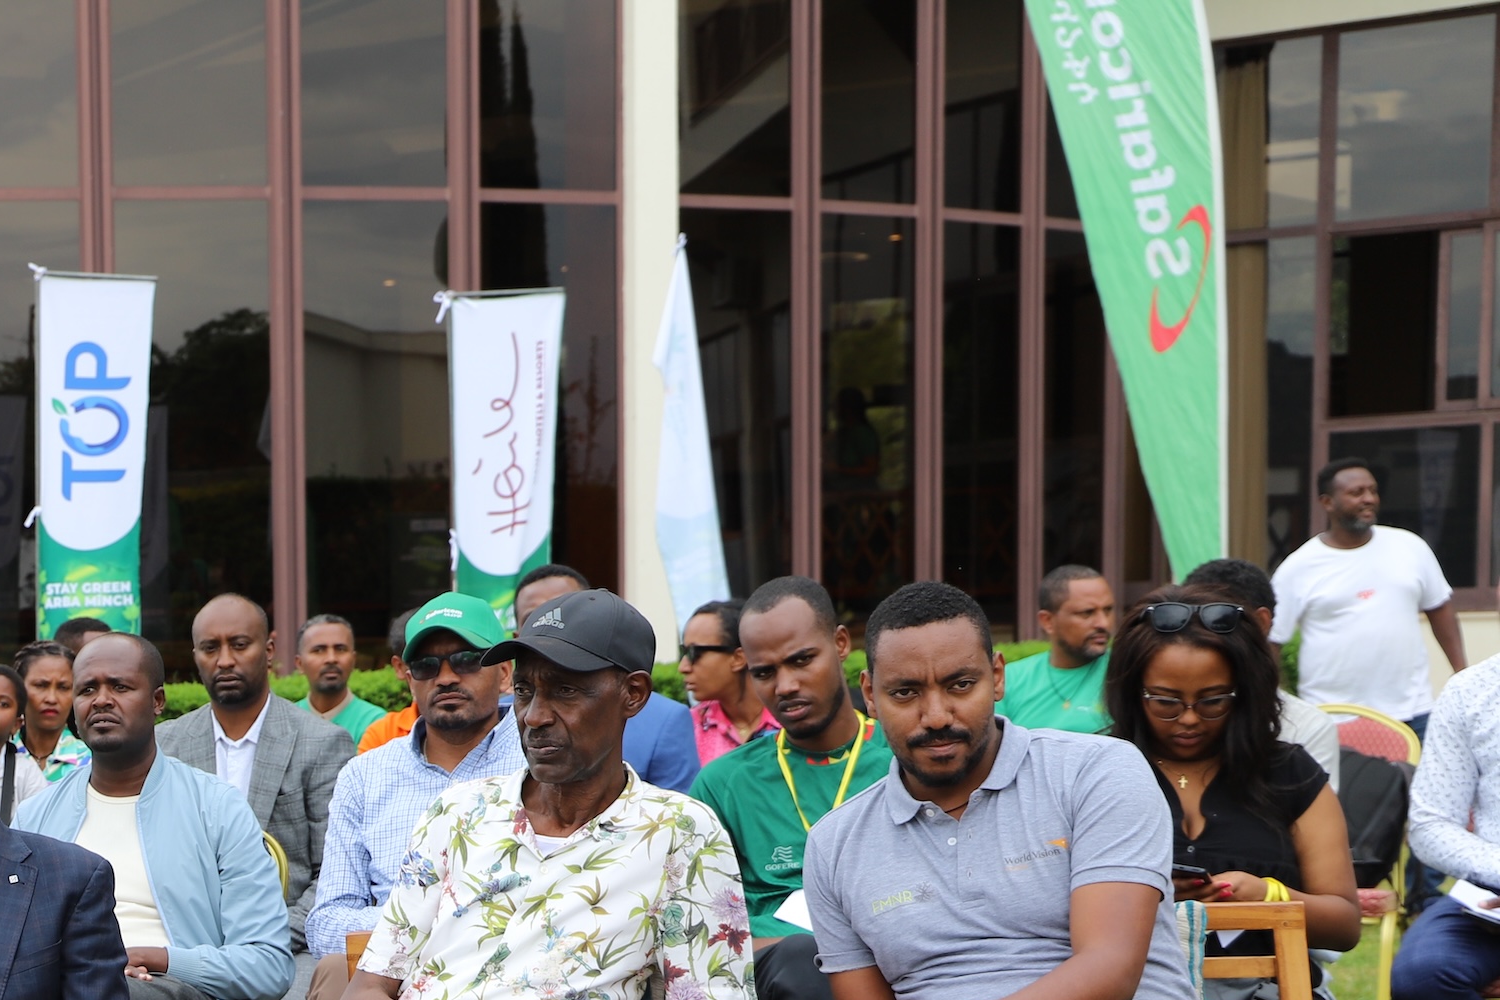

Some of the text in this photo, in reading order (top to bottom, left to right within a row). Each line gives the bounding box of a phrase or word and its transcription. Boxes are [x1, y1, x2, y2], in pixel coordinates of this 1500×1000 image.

[59, 341, 131, 502] TOP
[46, 581, 131, 595] STAY GREEN
[44, 595, 81, 609] ARBA
[532, 617, 565, 629] adidas
[1004, 849, 1061, 864] World Vision
